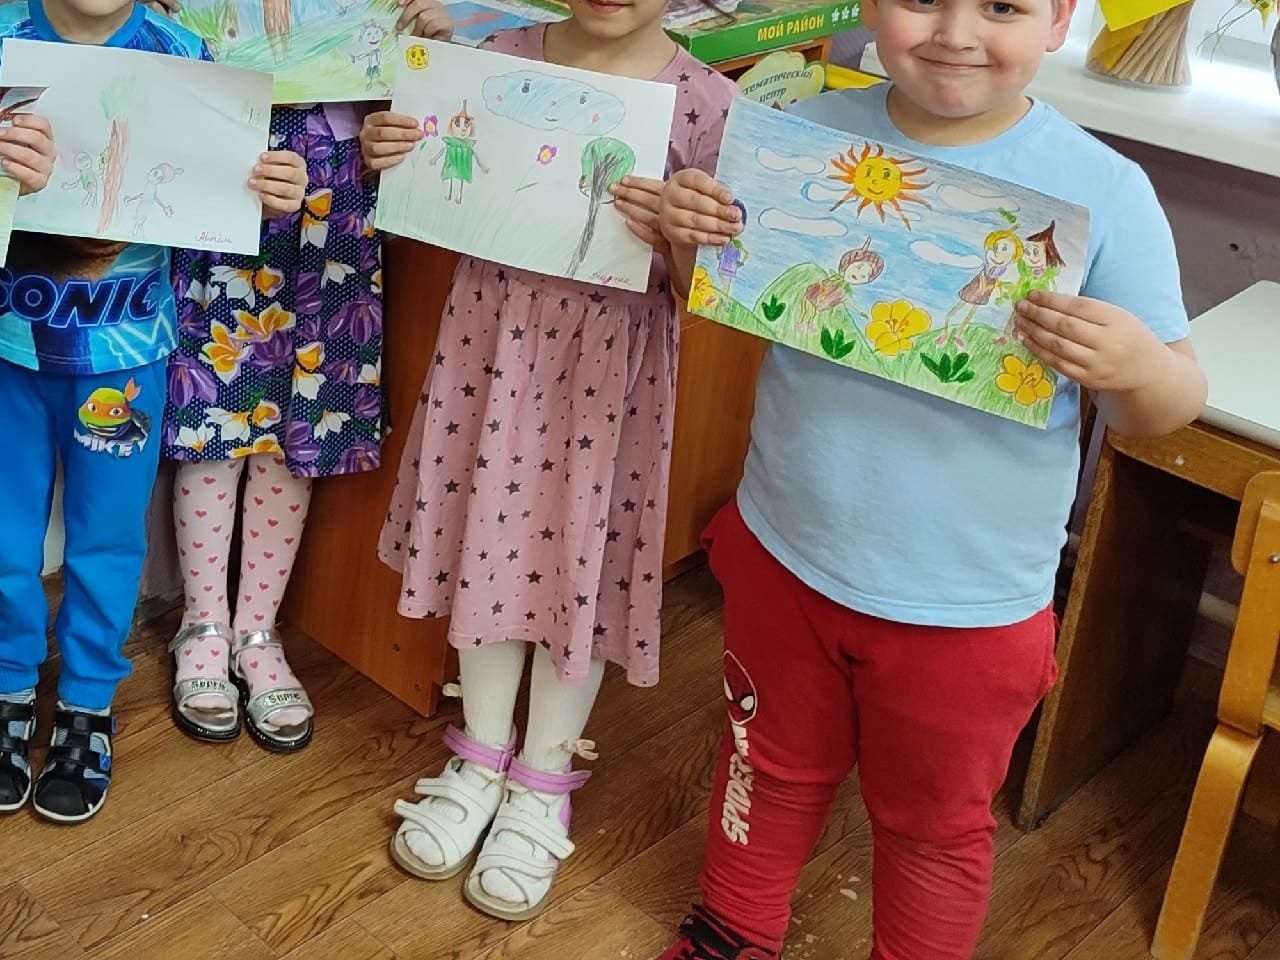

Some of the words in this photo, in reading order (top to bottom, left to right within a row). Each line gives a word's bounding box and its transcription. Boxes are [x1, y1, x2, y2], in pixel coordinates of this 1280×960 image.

[757, 25, 784, 41] МОЙ
[786, 14, 824, 38] РАЙОН
[759, 87, 787, 103] центр
